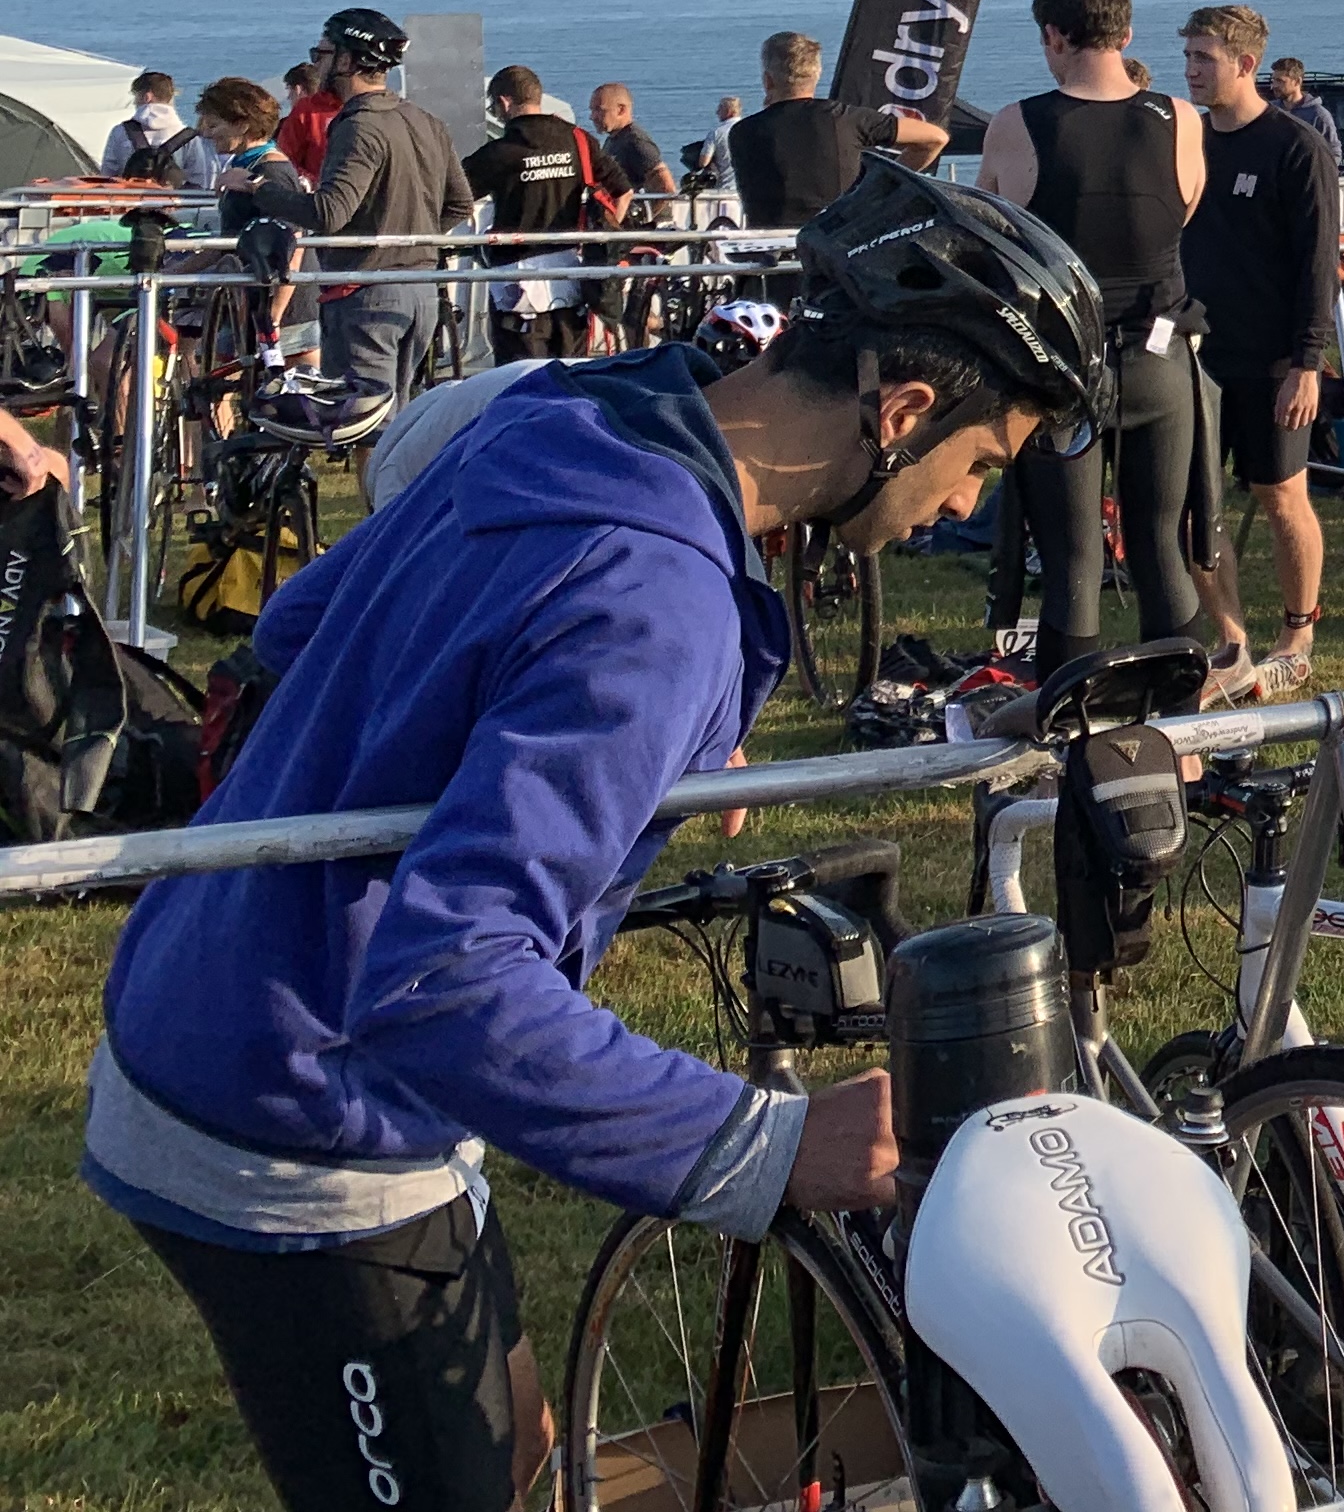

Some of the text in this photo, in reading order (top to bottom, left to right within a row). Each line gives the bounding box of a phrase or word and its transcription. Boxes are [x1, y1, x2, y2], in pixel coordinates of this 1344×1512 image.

[520, 166, 576, 183] CORNWALL
[522, 152, 573, 170] TRI-LOGIC
[1028, 1127, 1127, 1287] ADAMO
[342, 1361, 401, 1507] orca
